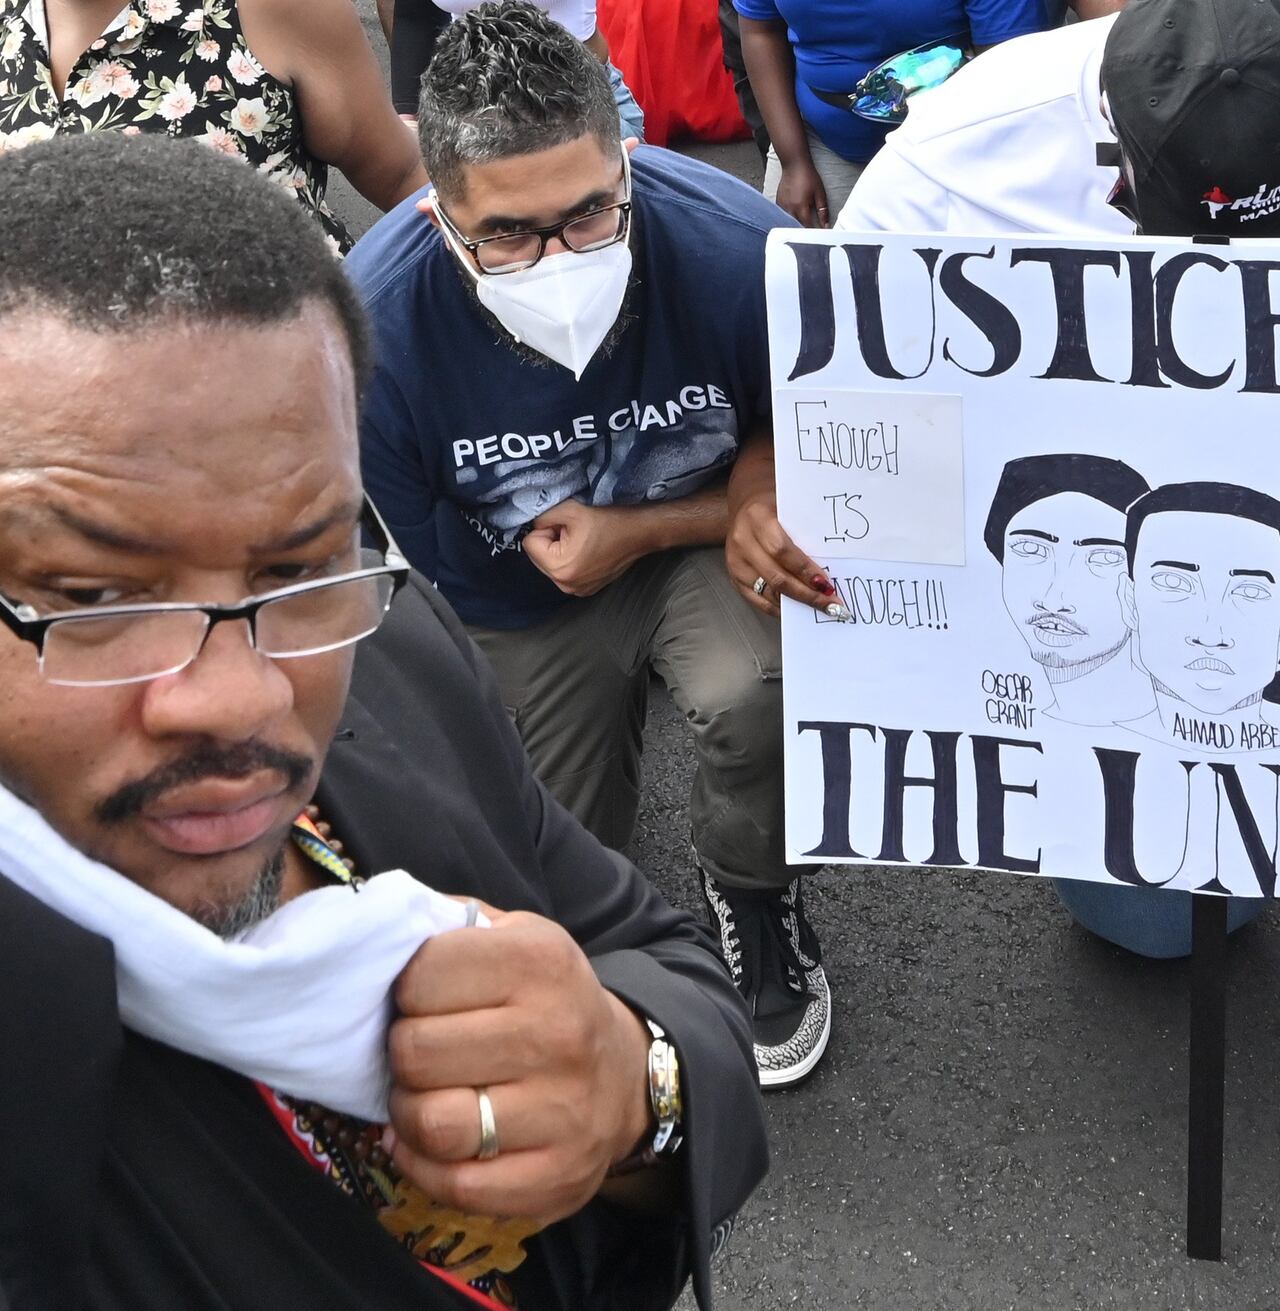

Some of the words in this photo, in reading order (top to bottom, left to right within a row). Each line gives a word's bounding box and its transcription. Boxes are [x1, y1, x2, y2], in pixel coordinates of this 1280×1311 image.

[453, 415, 598, 467] PEOPLE
[608, 384, 732, 431] CANGE
[795, 401, 899, 475] ENOUGH
[824, 493, 870, 543] IS
[981, 669, 1034, 705] OSCAR
[985, 699, 1037, 730] GRANT
[1172, 713, 1235, 750] AHMAUD
[797, 720, 1043, 876] THE
